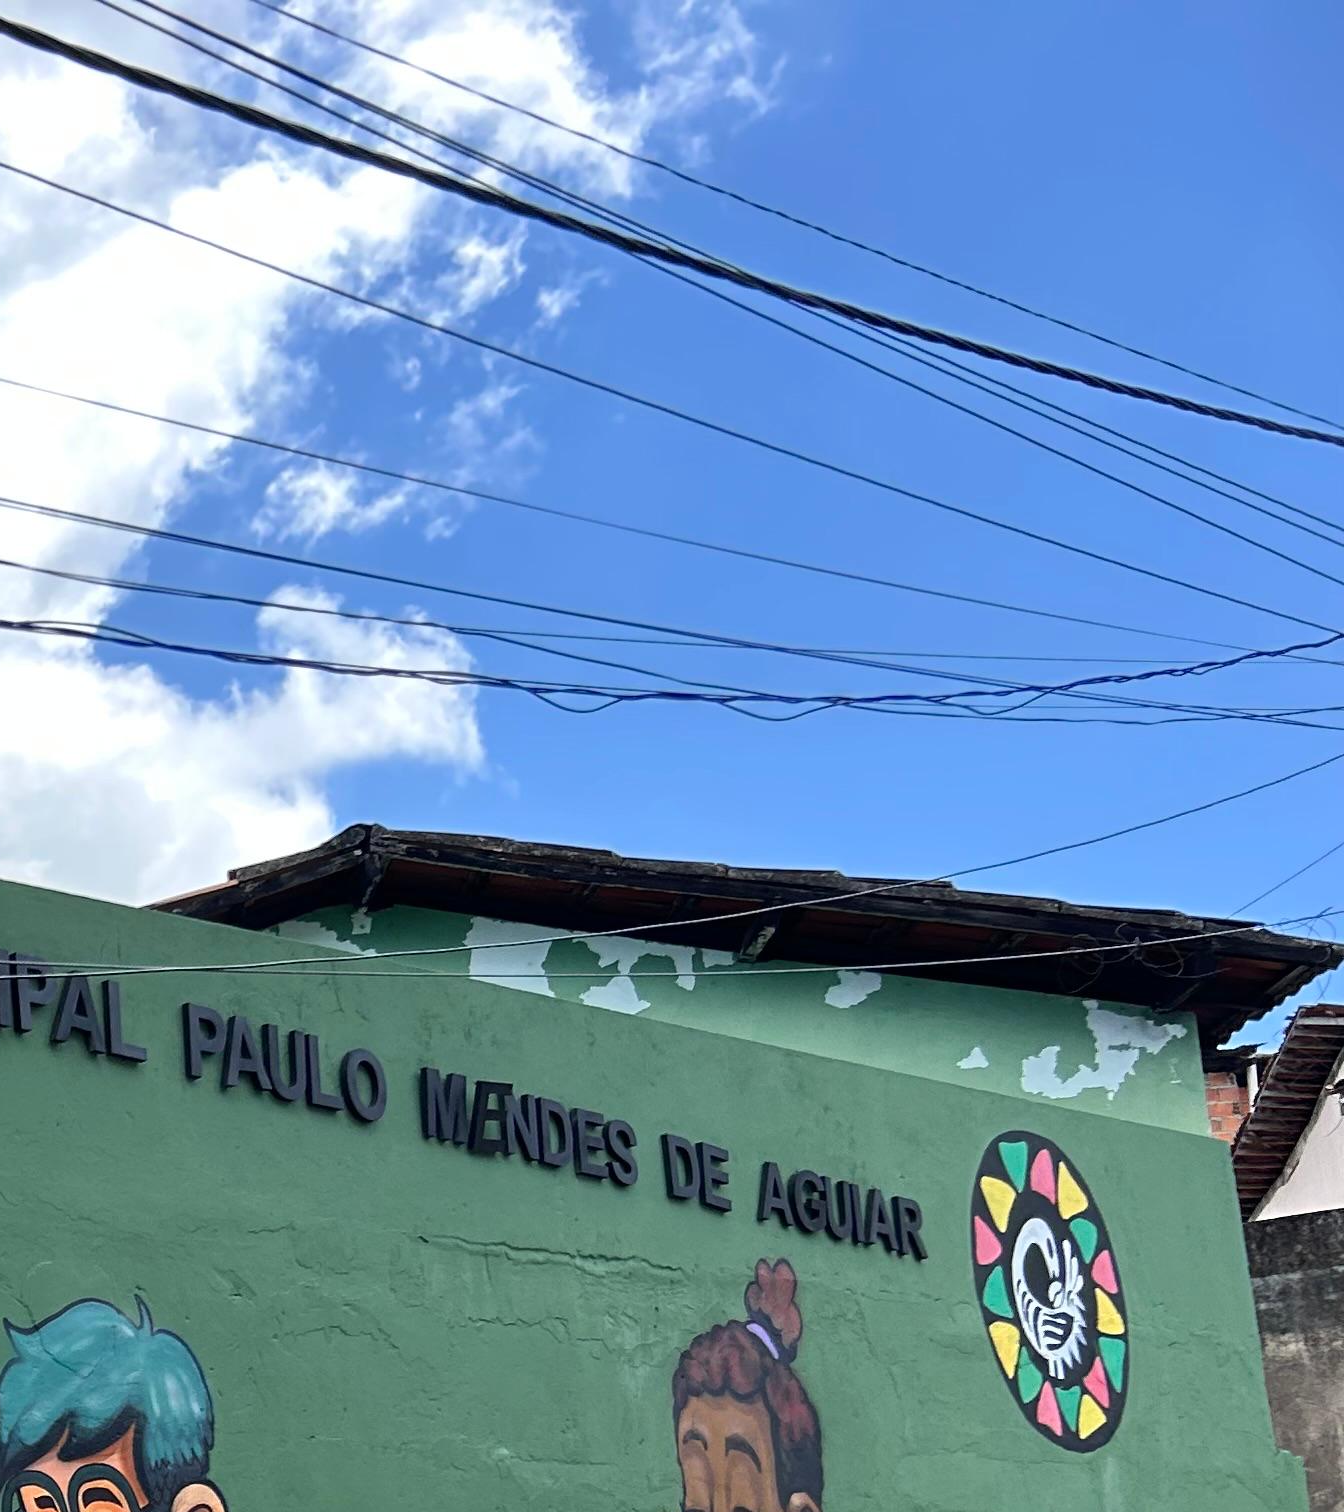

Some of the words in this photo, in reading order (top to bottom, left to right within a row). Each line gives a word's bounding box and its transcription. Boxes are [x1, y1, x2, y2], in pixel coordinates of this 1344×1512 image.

[182, 1002, 388, 1122] PAULO
[419, 1067, 639, 1187] MENDES
[661, 1133, 732, 1213] DE
[757, 1161, 928, 1262] AGUIAR
